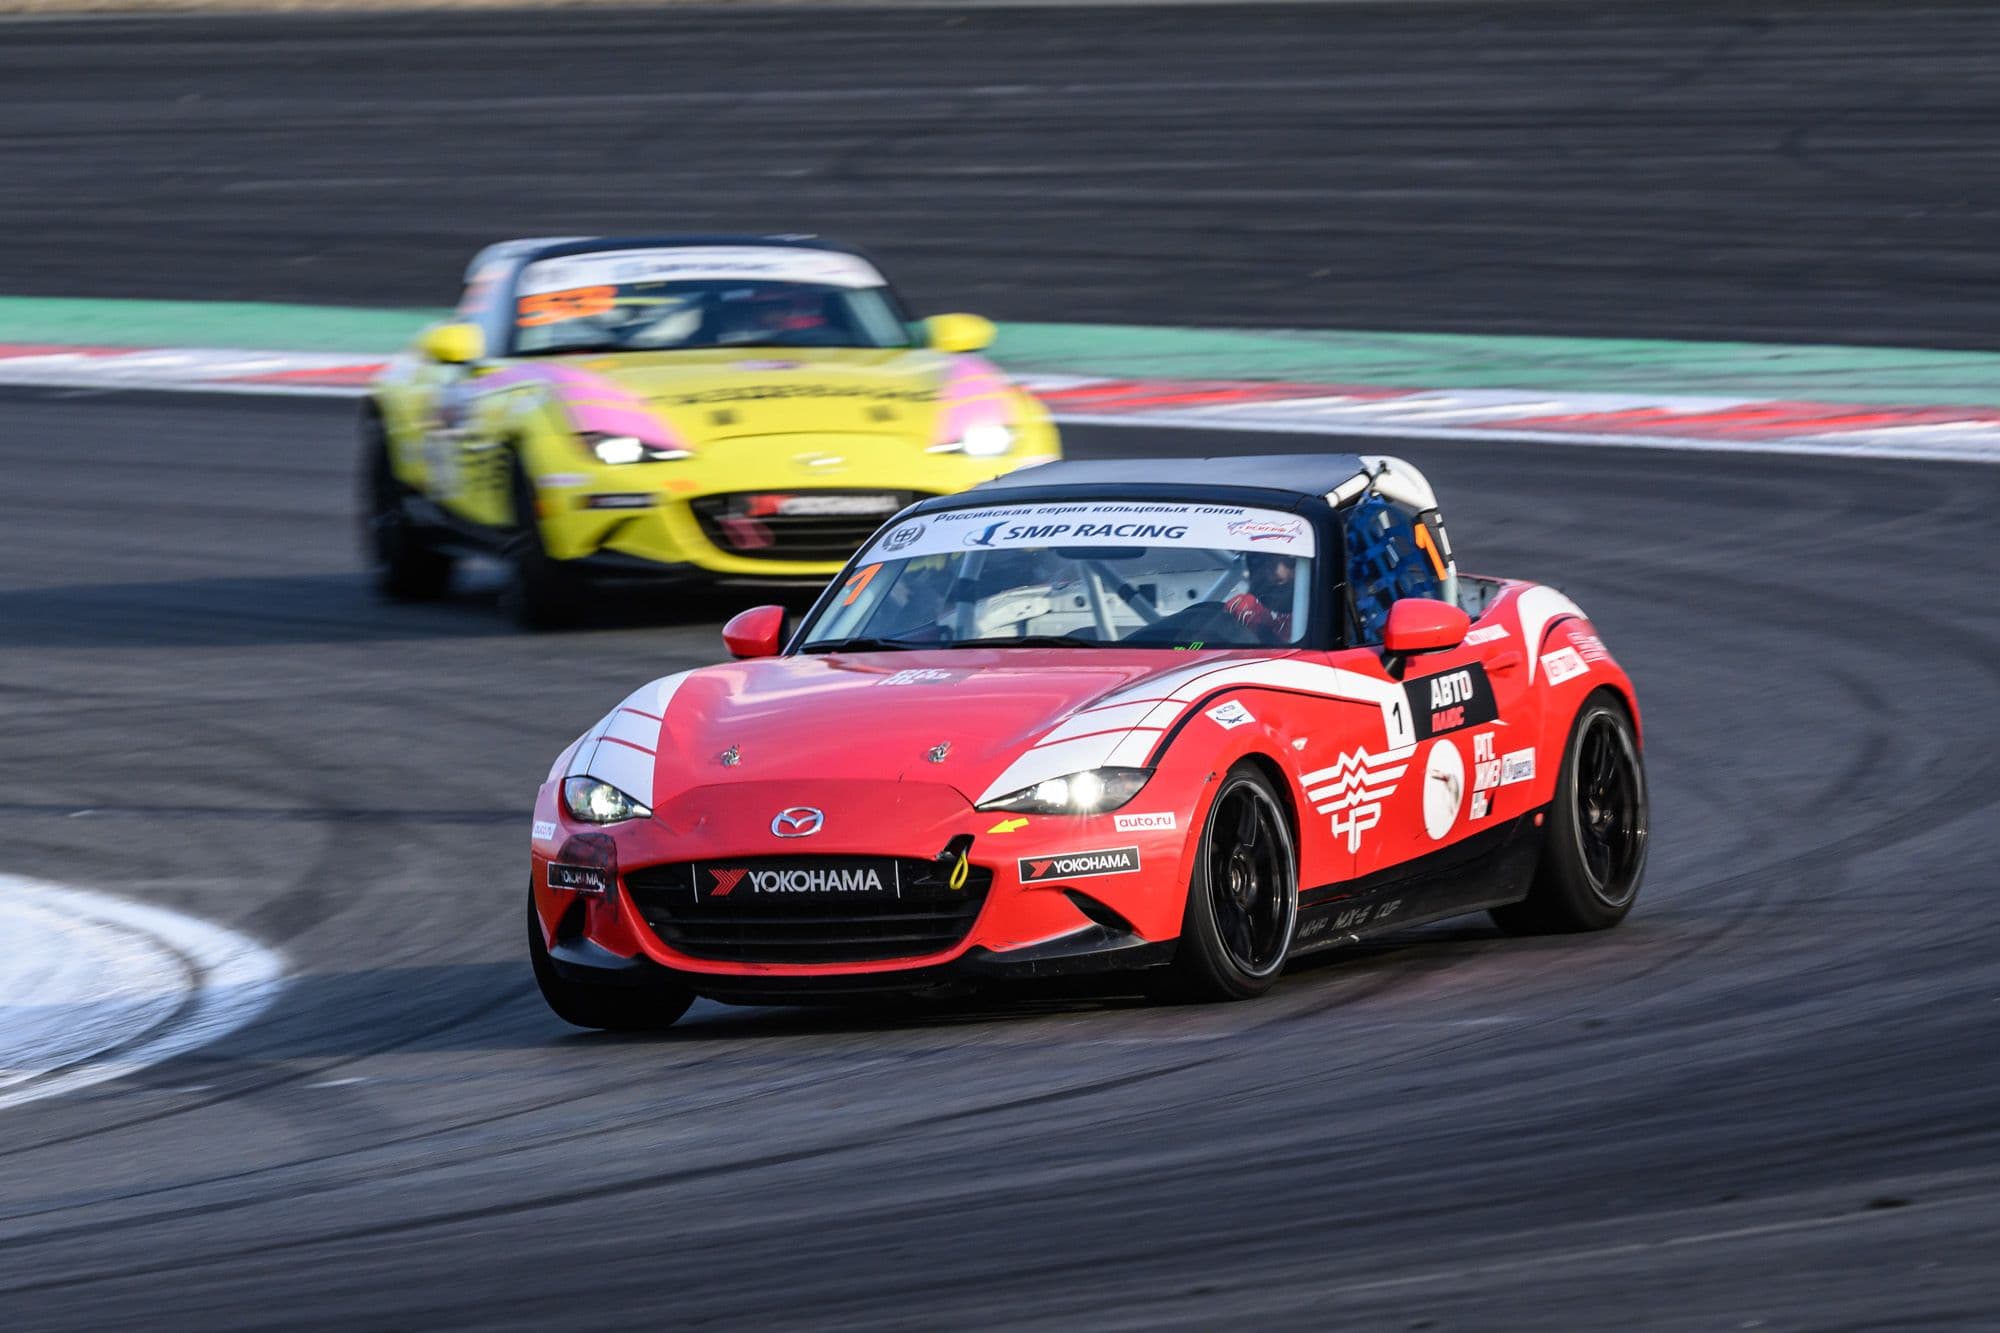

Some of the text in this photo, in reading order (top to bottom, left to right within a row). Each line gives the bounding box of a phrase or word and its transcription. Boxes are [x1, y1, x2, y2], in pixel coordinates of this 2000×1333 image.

[933, 505, 1246, 523] Российская серия кольцевых гонок
[1003, 524, 1188, 540] SMP RACING
[843, 562, 884, 607] 1
[1392, 701, 1404, 735] 1
[1119, 815, 1172, 828] auto.ru
[1054, 854, 1131, 874] YOKOHAMA
[748, 869, 883, 893] YOKOHAMA
